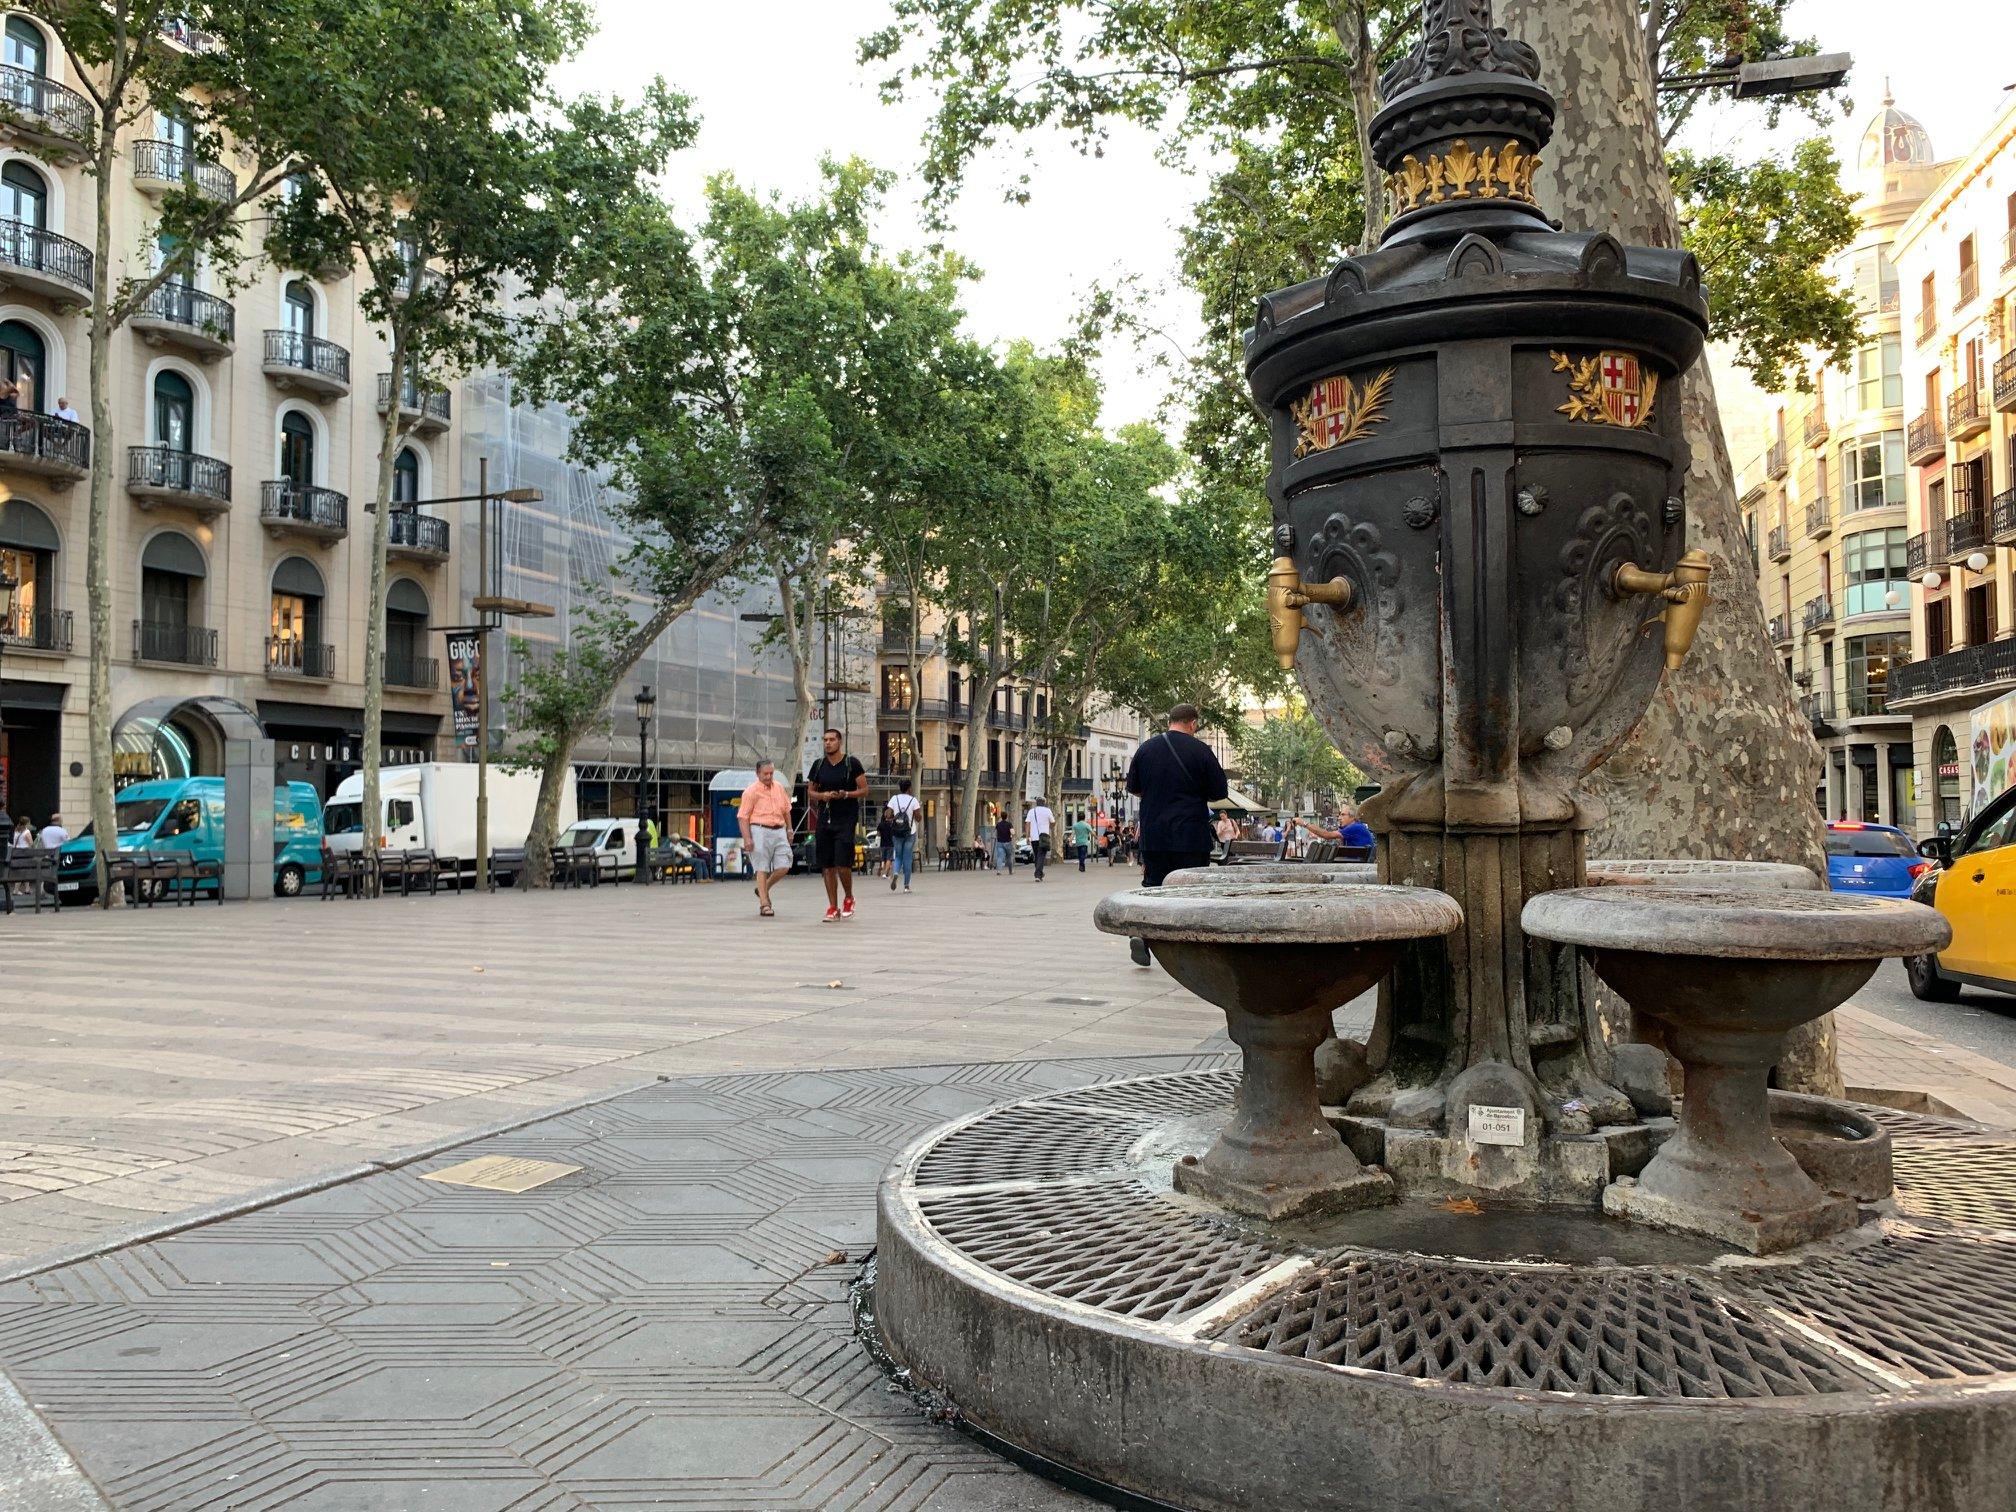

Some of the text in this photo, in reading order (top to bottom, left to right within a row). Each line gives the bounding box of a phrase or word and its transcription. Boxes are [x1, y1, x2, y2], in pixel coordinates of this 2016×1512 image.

[291, 744, 350, 762] CLUB
[1939, 766, 1959, 775] CASAS
[1482, 1122, 1511, 1132] 01-051
